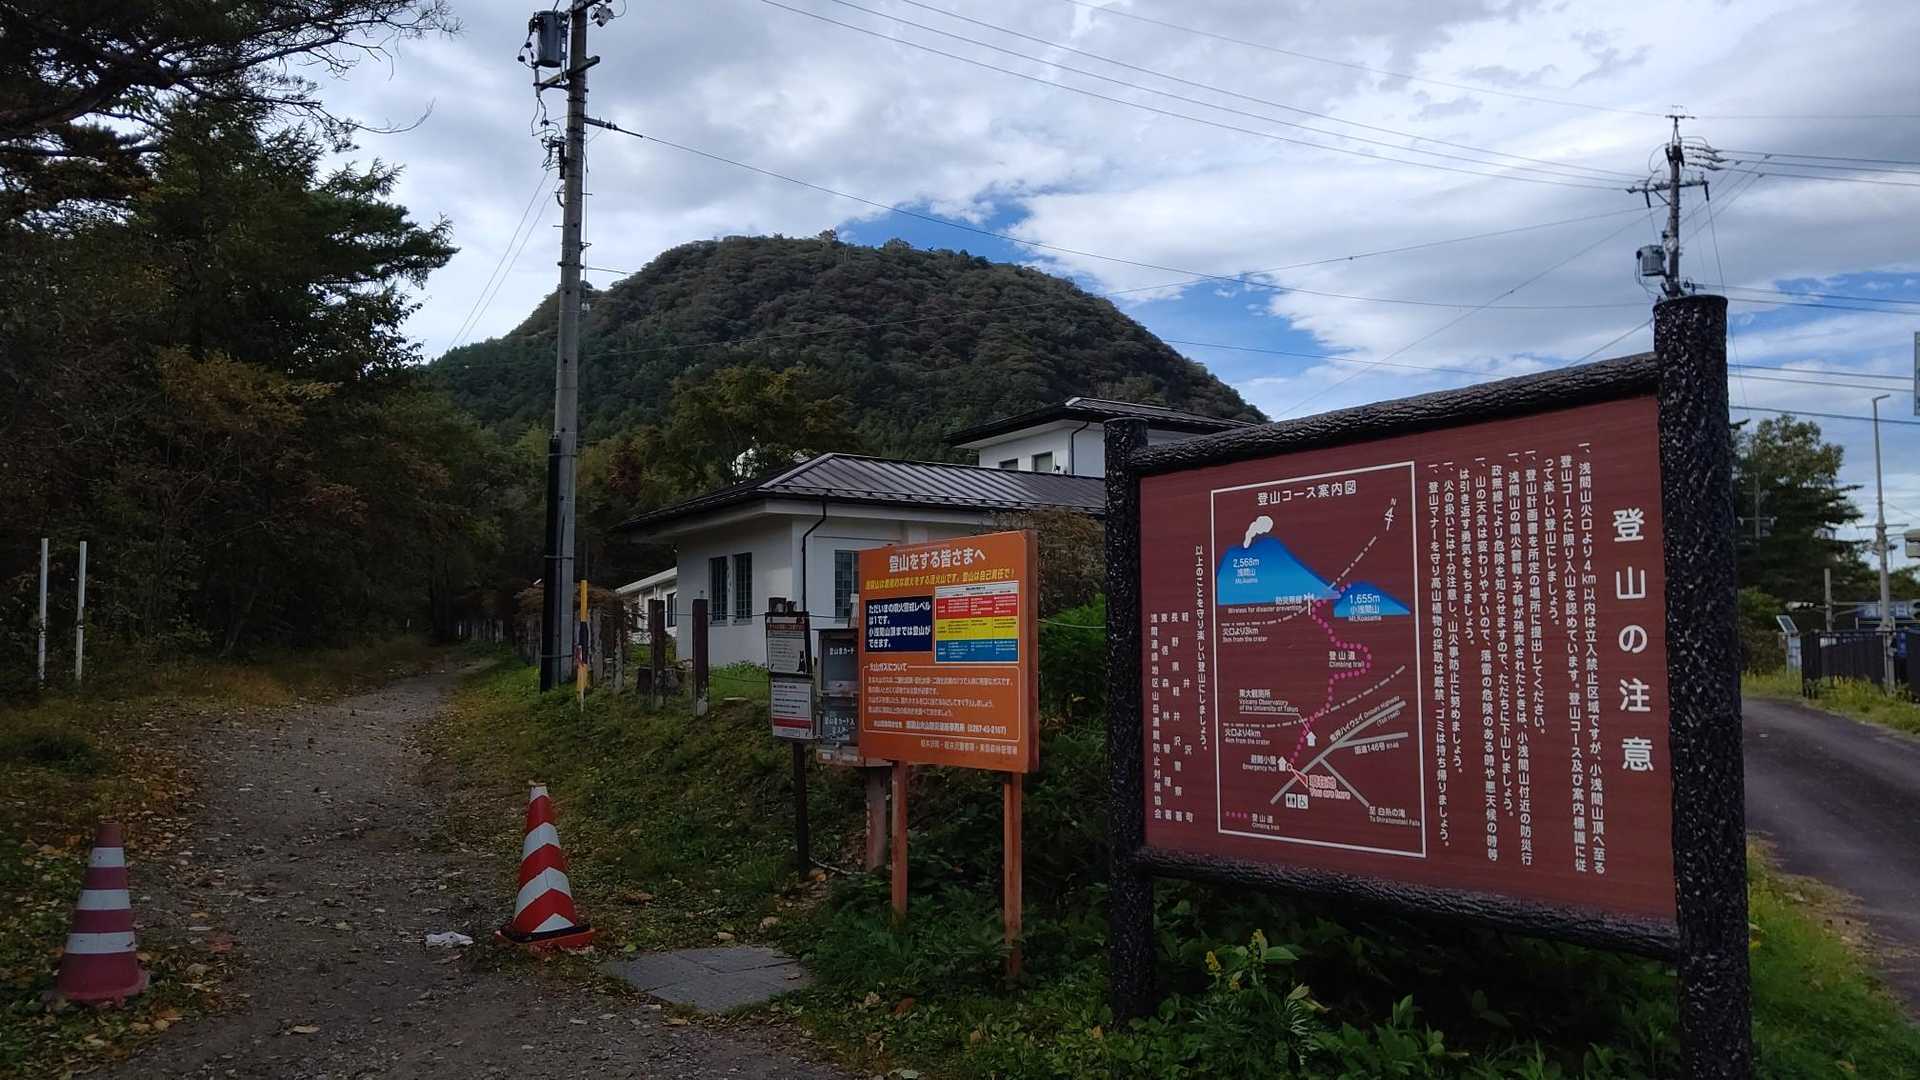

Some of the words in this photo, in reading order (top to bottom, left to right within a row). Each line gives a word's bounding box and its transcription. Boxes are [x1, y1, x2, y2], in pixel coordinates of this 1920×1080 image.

[1257, 480, 1356, 505] 登山コース案内図
[1543, 458, 1560, 625] って楽しい登山にしましょう。
[889, 548, 986, 573] 登山をする皆さまへ
[1459, 468, 1475, 645] は引き返す勇気をもちましょう。
[1349, 594, 1381, 604] 1,655m
[868, 639, 892, 649] できます。
[1612, 508, 1654, 772] 登山の注意
